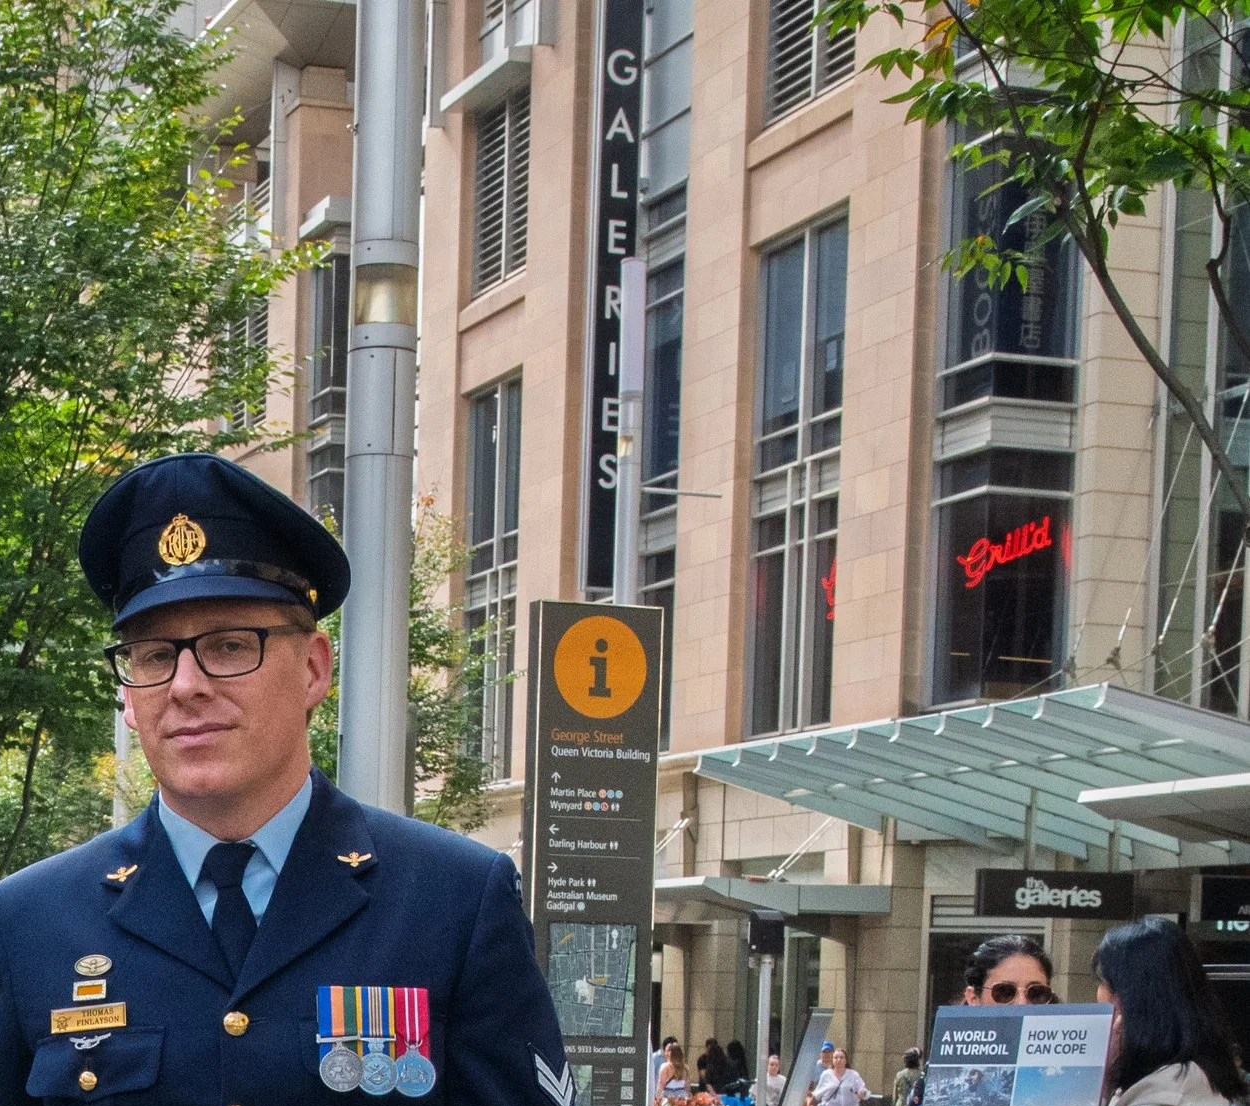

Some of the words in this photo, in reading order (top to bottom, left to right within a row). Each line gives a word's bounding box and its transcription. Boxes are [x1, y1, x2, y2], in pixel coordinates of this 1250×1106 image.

[598, 49, 638, 489] GALERIES
[551, 728, 590, 745] George
[593, 730, 623, 744] Street
[551, 745, 579, 757] Queen
[581, 746, 614, 759] Victoria
[616, 748, 650, 763] Building
[550, 787, 575, 797] Martin
[577, 788, 597, 798] Place
[550, 800, 582, 812] Wynyard
[549, 838, 576, 850] Darling
[578, 839, 607, 850] Harbour
[547, 877, 566, 888] Hyde
[569, 877, 585, 887] Park
[1026, 877, 1045, 889] the
[547, 890, 584, 900] Australian
[586, 891, 618, 901] Museum
[546, 901, 575, 913] Gadigal
[82, 1008, 114, 1017] THOMAS
[77, 1016, 119, 1026] FINLAYSON
[942, 1030, 951, 1042] A
[953, 1030, 997, 1042] WORLD
[1028, 1030, 1058, 1041] HOW
[1061, 1029, 1088, 1041] YOU
[564, 1045, 576, 1053] 265
[593, 1045, 616, 1054] location
[940, 1044, 954, 1056] IN
[956, 1043, 1009, 1056] TURMOIL
[1026, 1043, 1051, 1055] CAN
[1053, 1043, 1087, 1055] COPE
